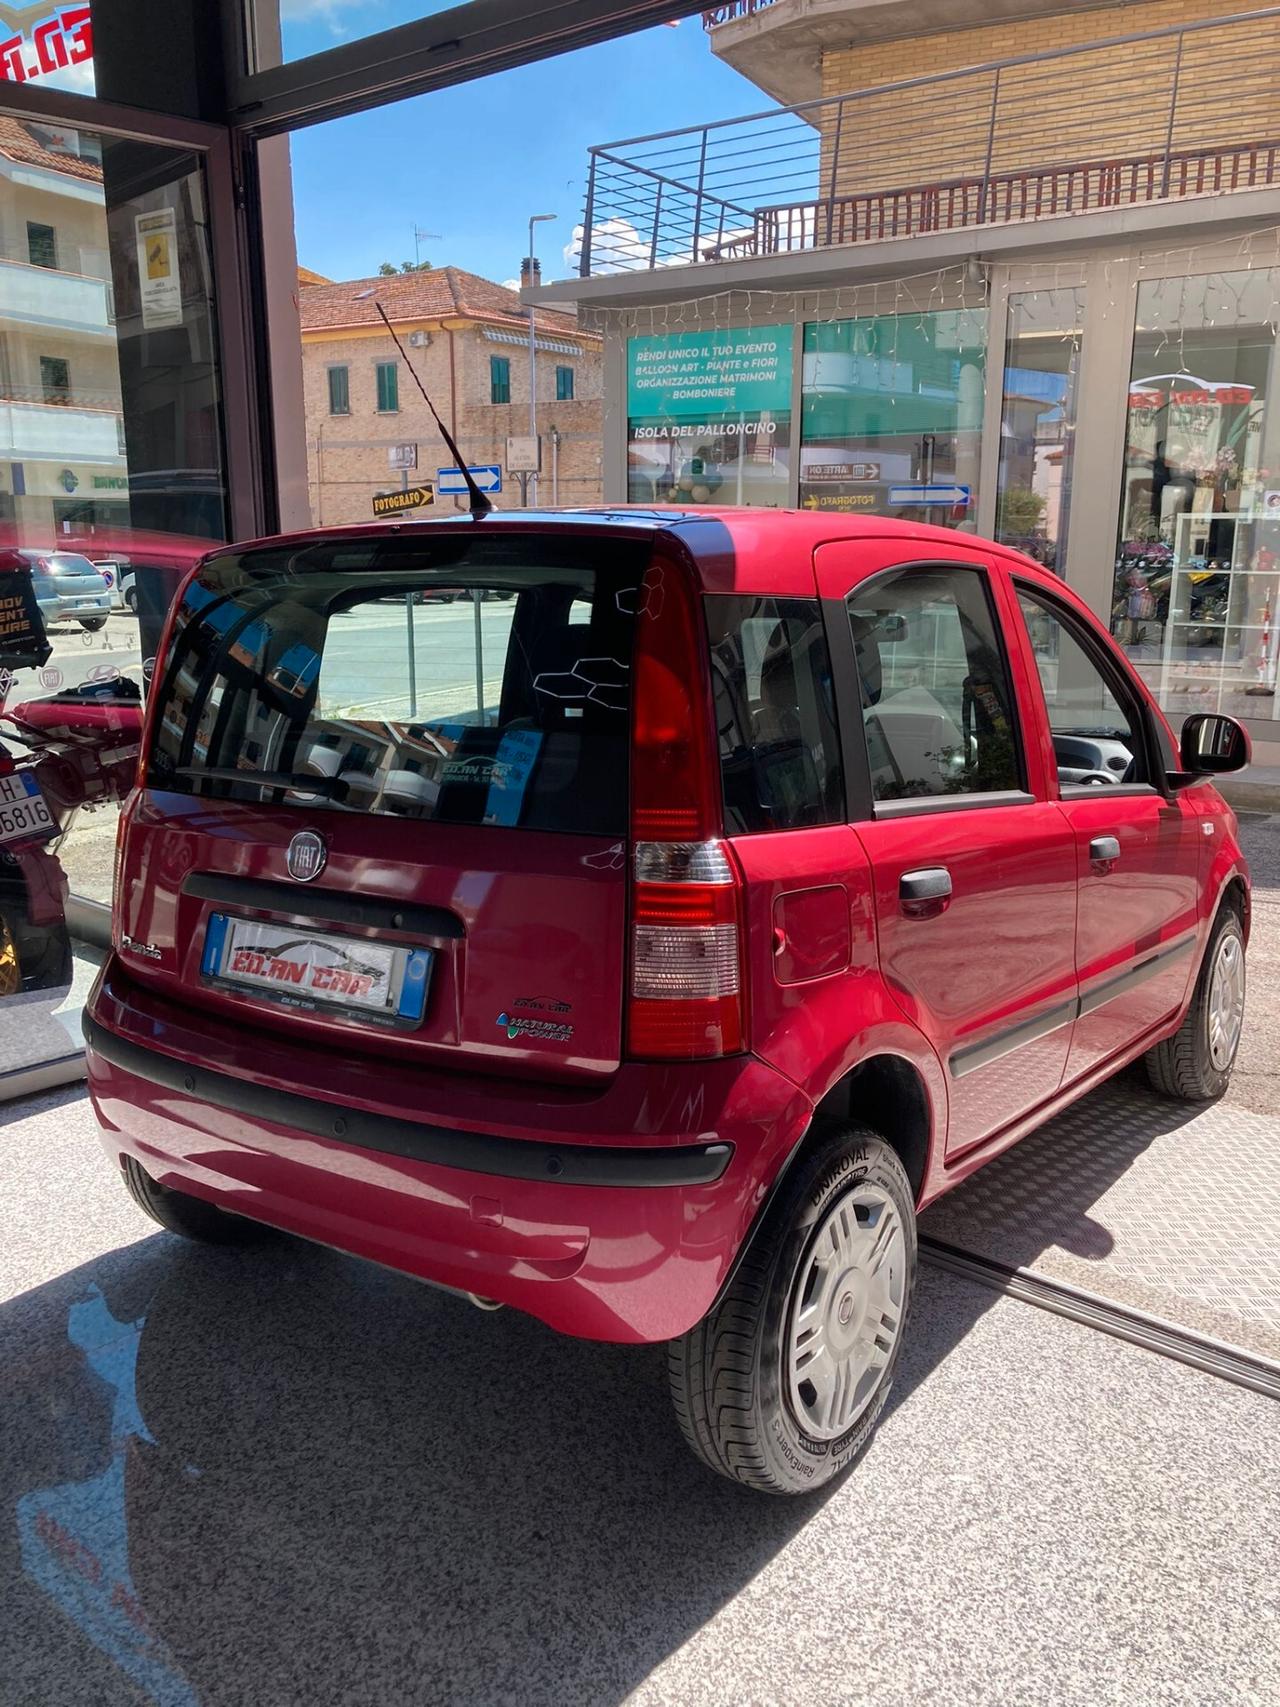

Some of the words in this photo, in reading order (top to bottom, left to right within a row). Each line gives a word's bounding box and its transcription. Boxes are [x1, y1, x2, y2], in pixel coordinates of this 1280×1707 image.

[636, 350, 666, 362] RENDI
[668, 348, 699, 360] UNICO
[701, 347, 710, 357] IL
[712, 346, 733, 357] TUO
[735, 342, 777, 355] EVENTO
[635, 364, 678, 376] BALLOON
[680, 362, 699, 373] ART
[706, 360, 741, 371] PIANTE
[751, 357, 778, 368] FIORI
[636, 374, 718, 388] ORGANIZZAZIONE
[719, 371, 777, 383] MATRIMONI
[672, 387, 736, 399] BOMBONIERE
[634, 427, 668, 439] ISOLA
[671, 425, 694, 437] DEL
[697, 422, 777, 436] PALLONCINO
[374, 491, 420, 511] FOTOGRAFO
[0, 801, 49, 836] 6816
[294, 845, 317, 868] FIAT
[311, 966, 375, 997] CAR
[810, 1147, 869, 1207] UNIROYAL
[776, 1431, 815, 1478] RainExpert
